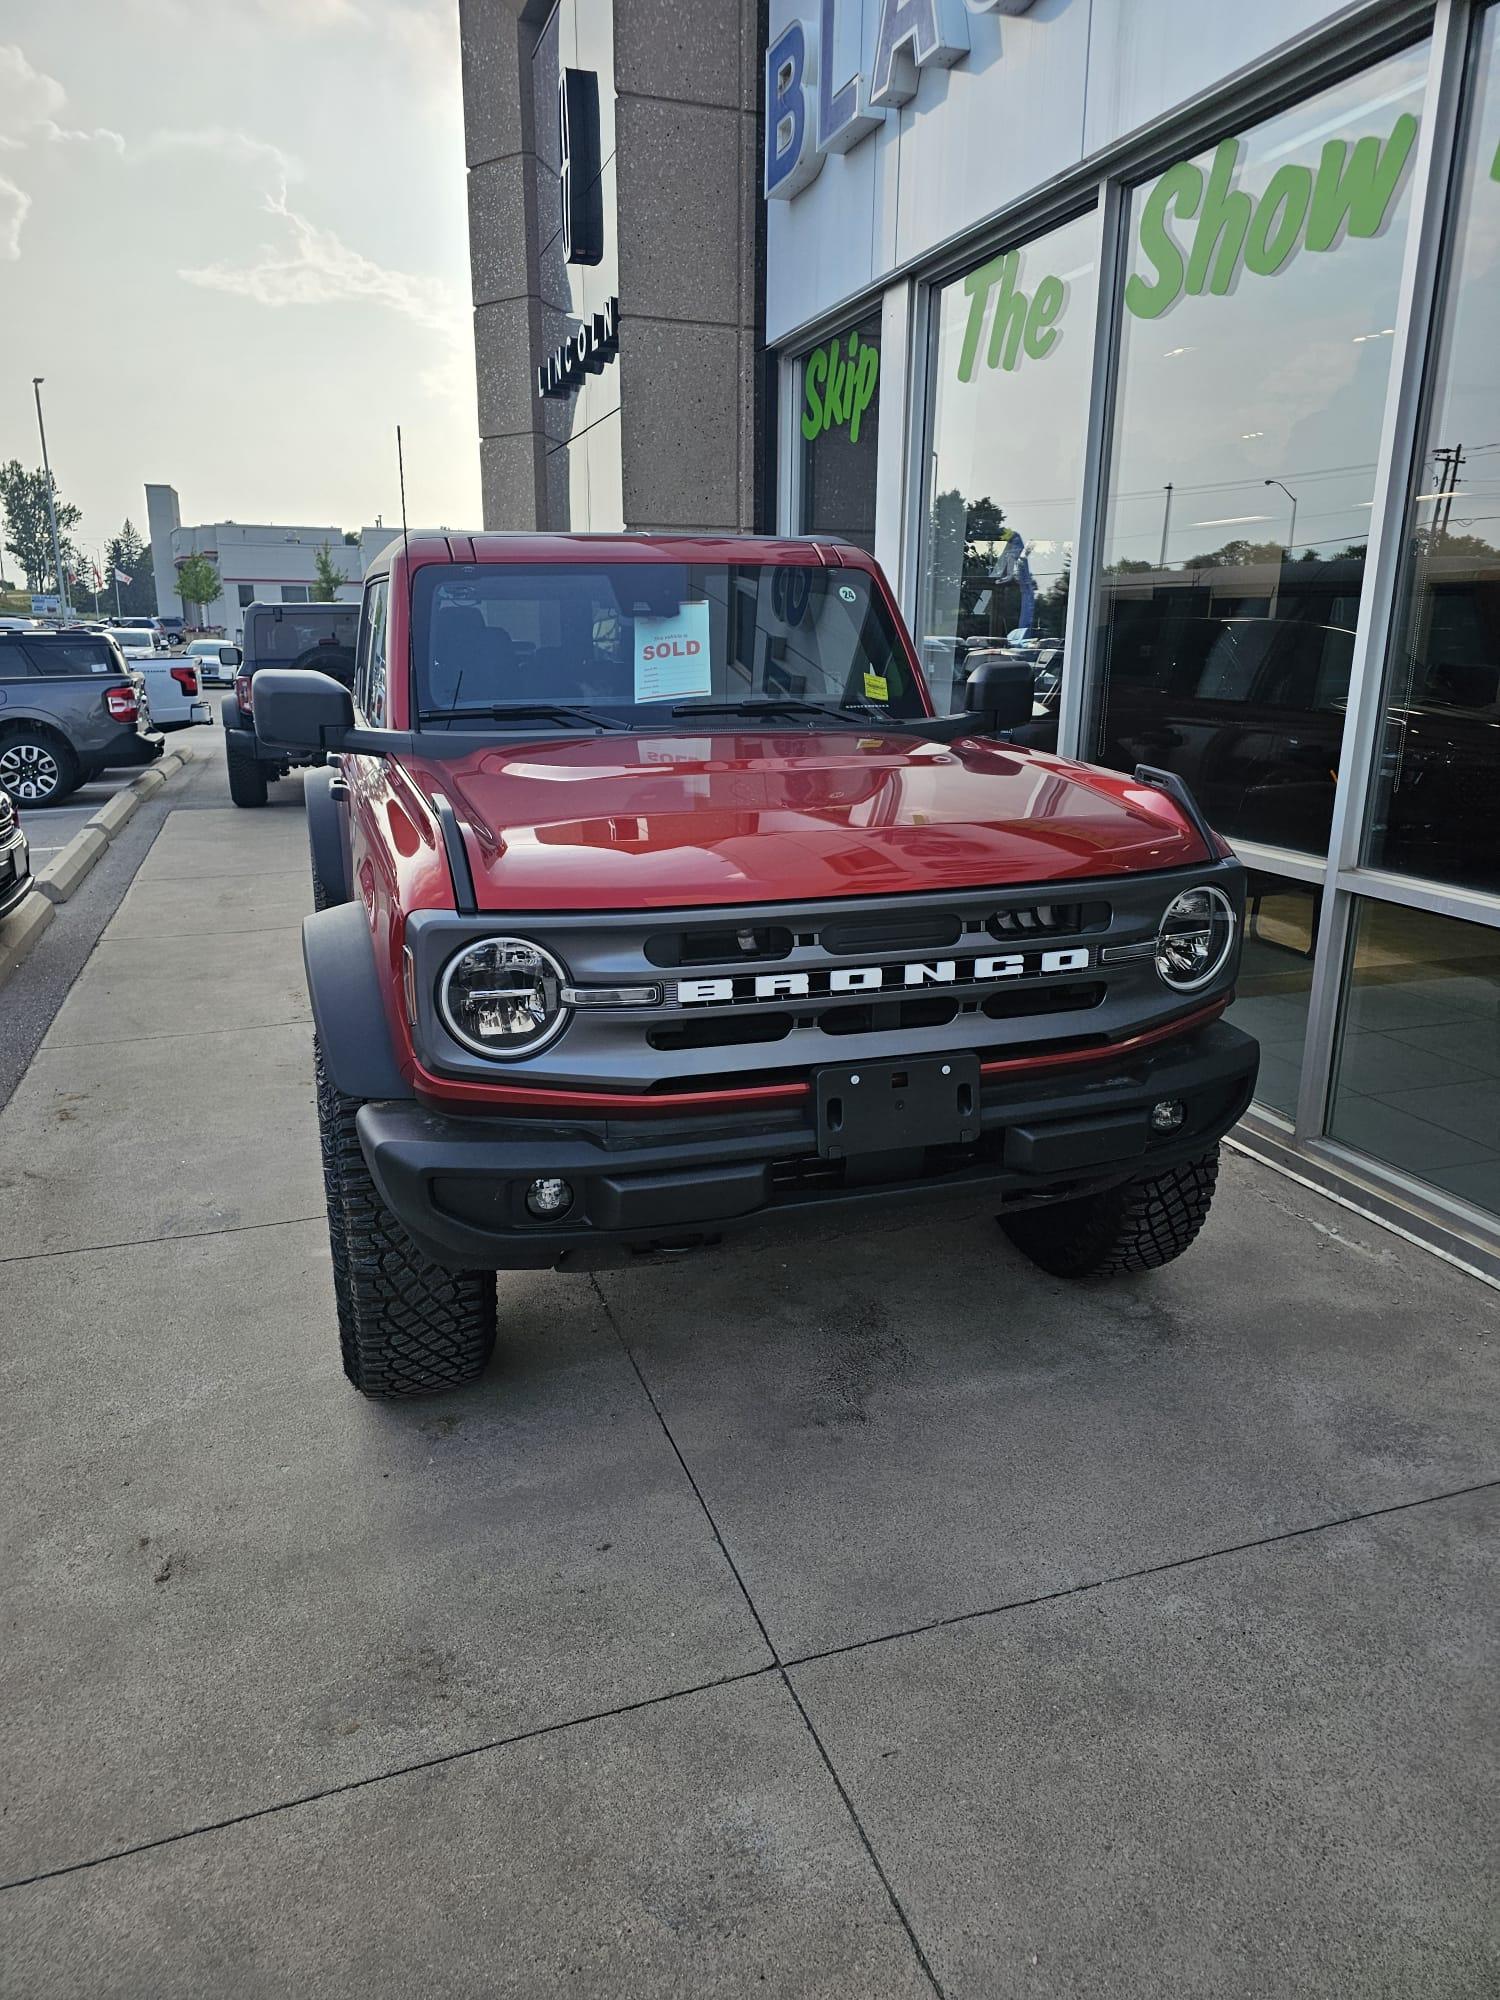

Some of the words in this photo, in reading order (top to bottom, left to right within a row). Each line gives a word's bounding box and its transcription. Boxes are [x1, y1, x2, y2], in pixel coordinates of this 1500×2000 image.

[801, 331, 878, 443] Skip
[957, 249, 1066, 383] The
[1125, 112, 1419, 320] Show
[538, 295, 614, 398] LINCOLN
[842, 589, 855, 600] 24
[643, 640, 701, 661] SOLD
[677, 949, 1089, 1003] BRONCO
